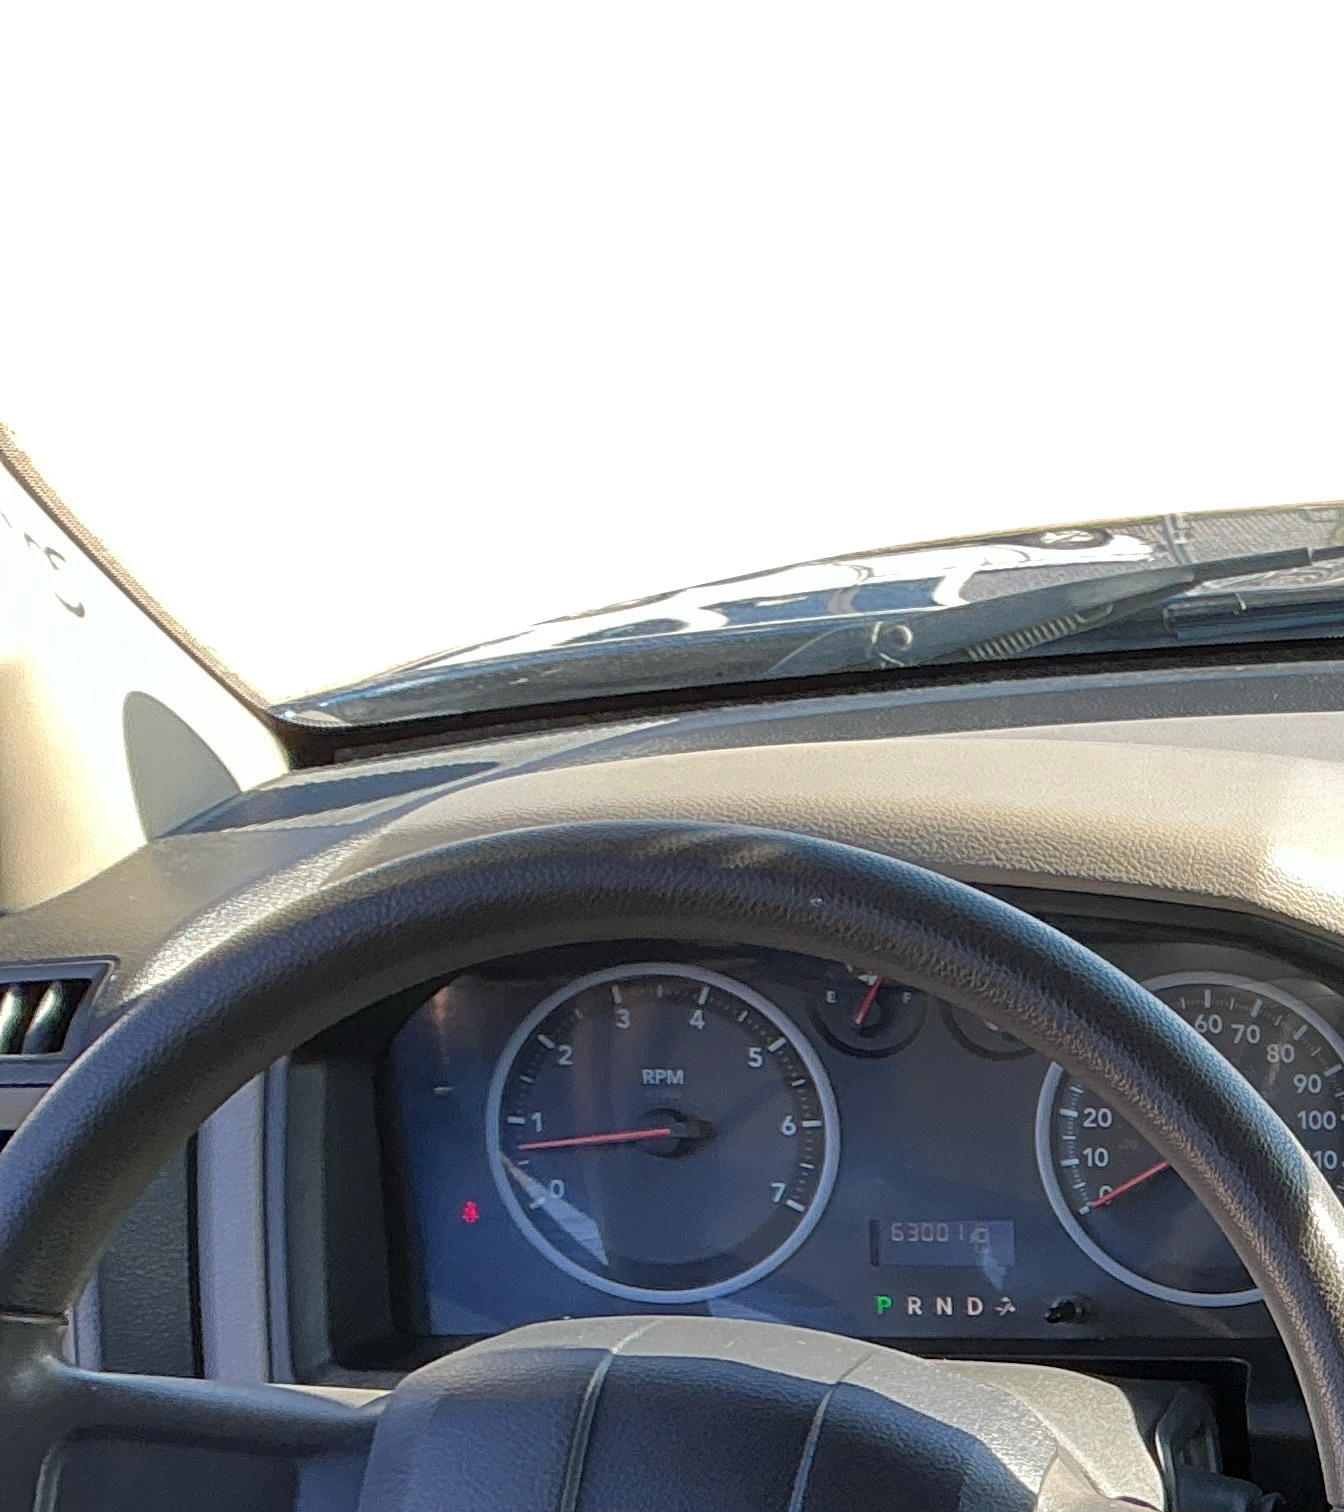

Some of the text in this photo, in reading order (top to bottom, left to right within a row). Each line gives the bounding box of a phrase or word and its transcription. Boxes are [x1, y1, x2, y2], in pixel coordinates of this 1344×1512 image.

[826, 990, 837, 1003] E
[614, 1009, 631, 1030] 3
[689, 1009, 706, 1030] 4
[1194, 1013, 1223, 1034] 60
[1231, 1024, 1261, 1044] 70
[557, 1045, 574, 1065] 2
[747, 1047, 764, 1068] 5
[1266, 1043, 1295, 1064] 80
[641, 1069, 685, 1085] RPM
[1293, 1074, 1322, 1094] 90
[530, 1113, 543, 1132] 1
[780, 1116, 797, 1136] 6
[1082, 1107, 1113, 1128] 20
[1297, 1110, 1337, 1130] 100
[1082, 1147, 1109, 1167] 10
[549, 1180, 565, 1199] 0
[771, 1183, 787, 1202] 7
[876, 1296, 984, 1316] P R N D
